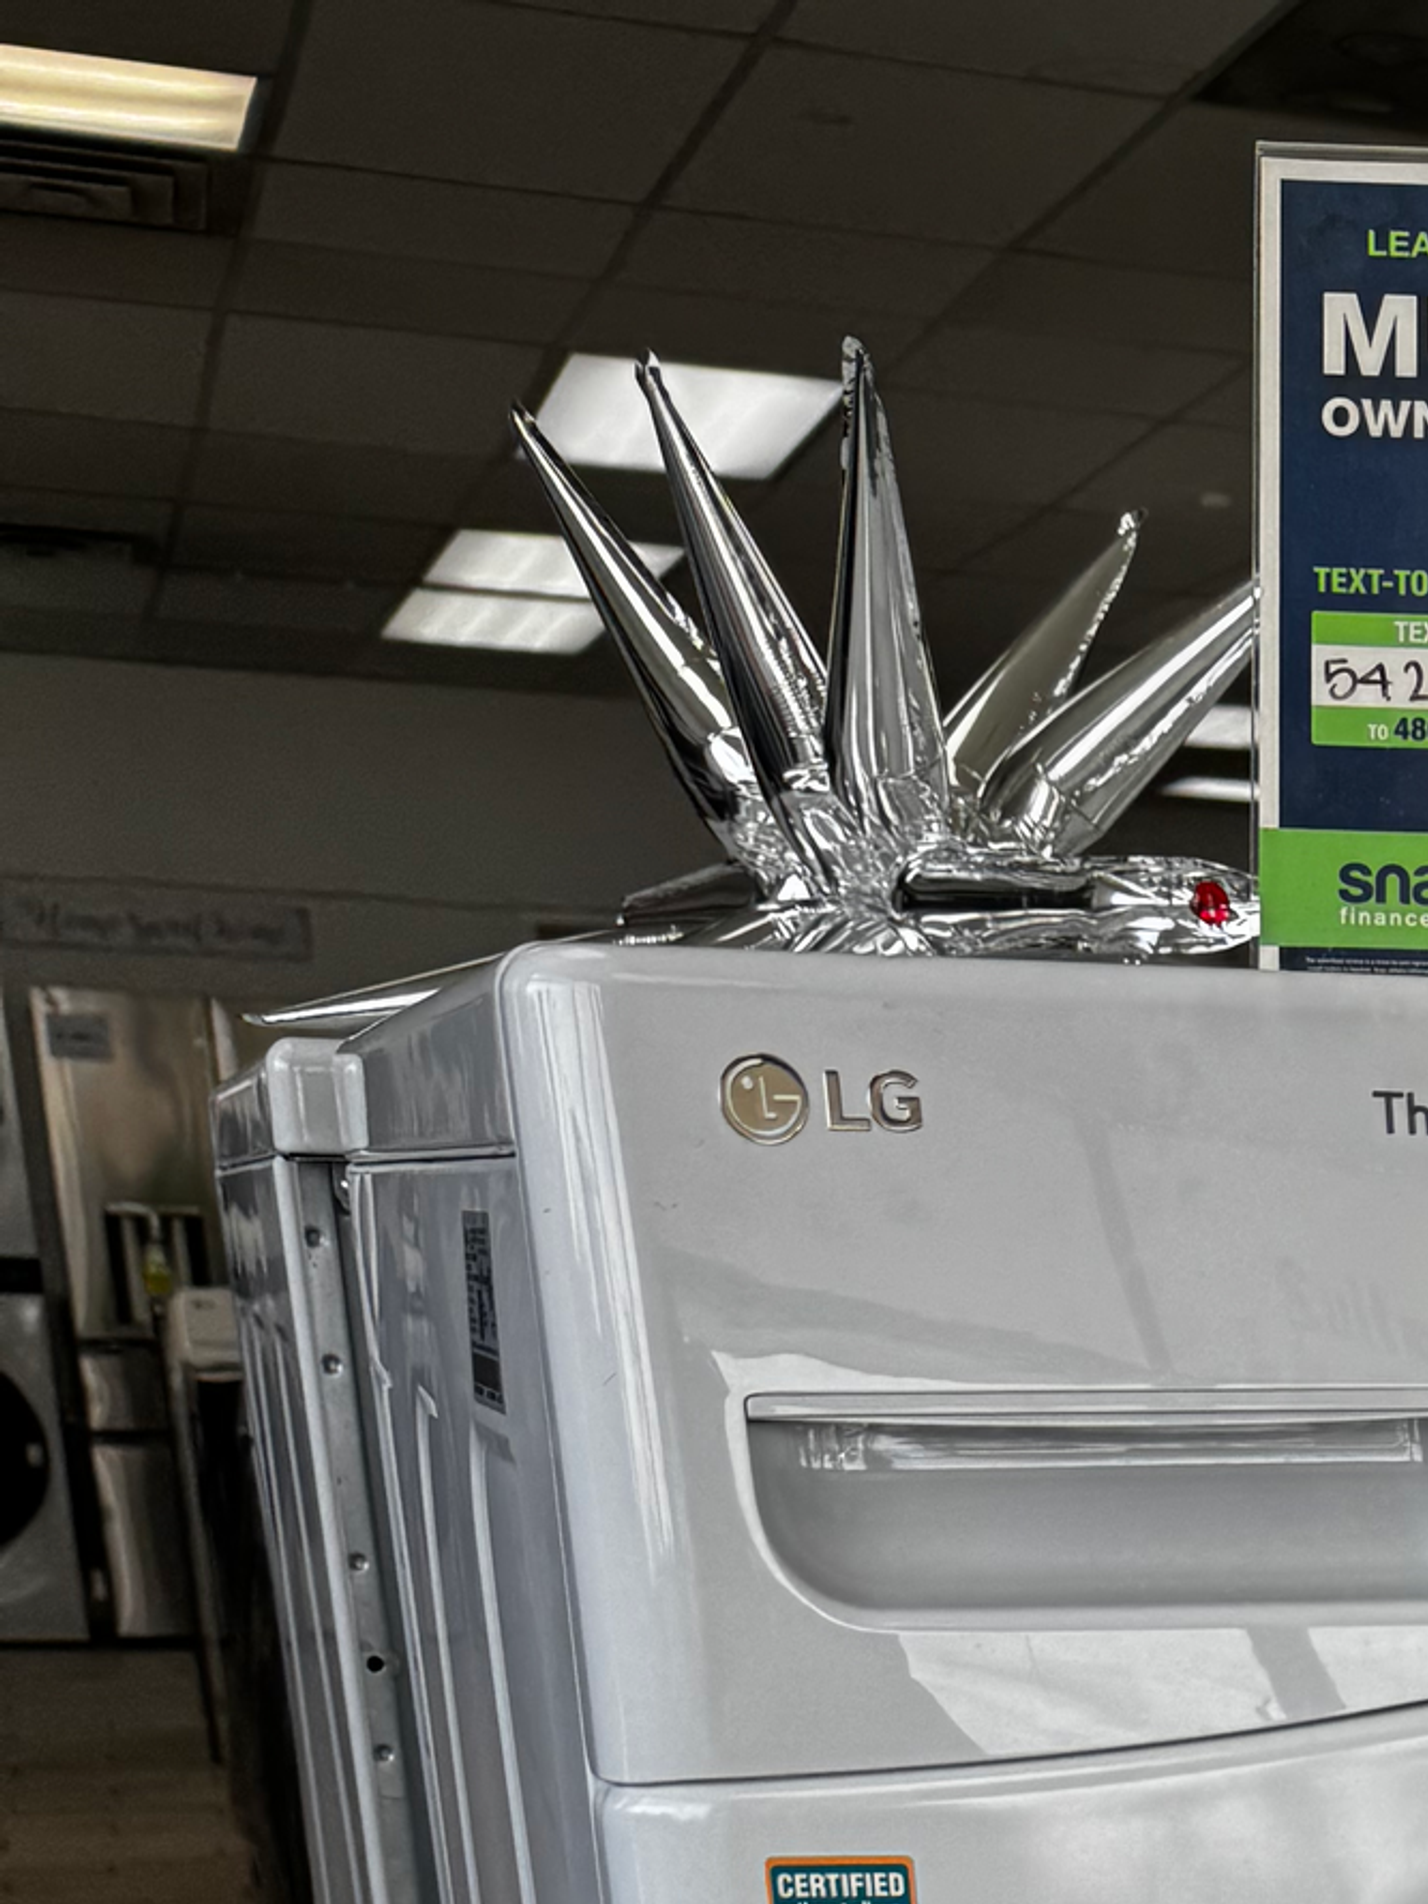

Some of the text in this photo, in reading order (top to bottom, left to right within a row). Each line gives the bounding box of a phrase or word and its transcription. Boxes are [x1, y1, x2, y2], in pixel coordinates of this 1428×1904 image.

[1367, 723, 1390, 740] TO
[823, 1067, 923, 1133] LG
[776, 1871, 906, 1899] CERTIFIED
